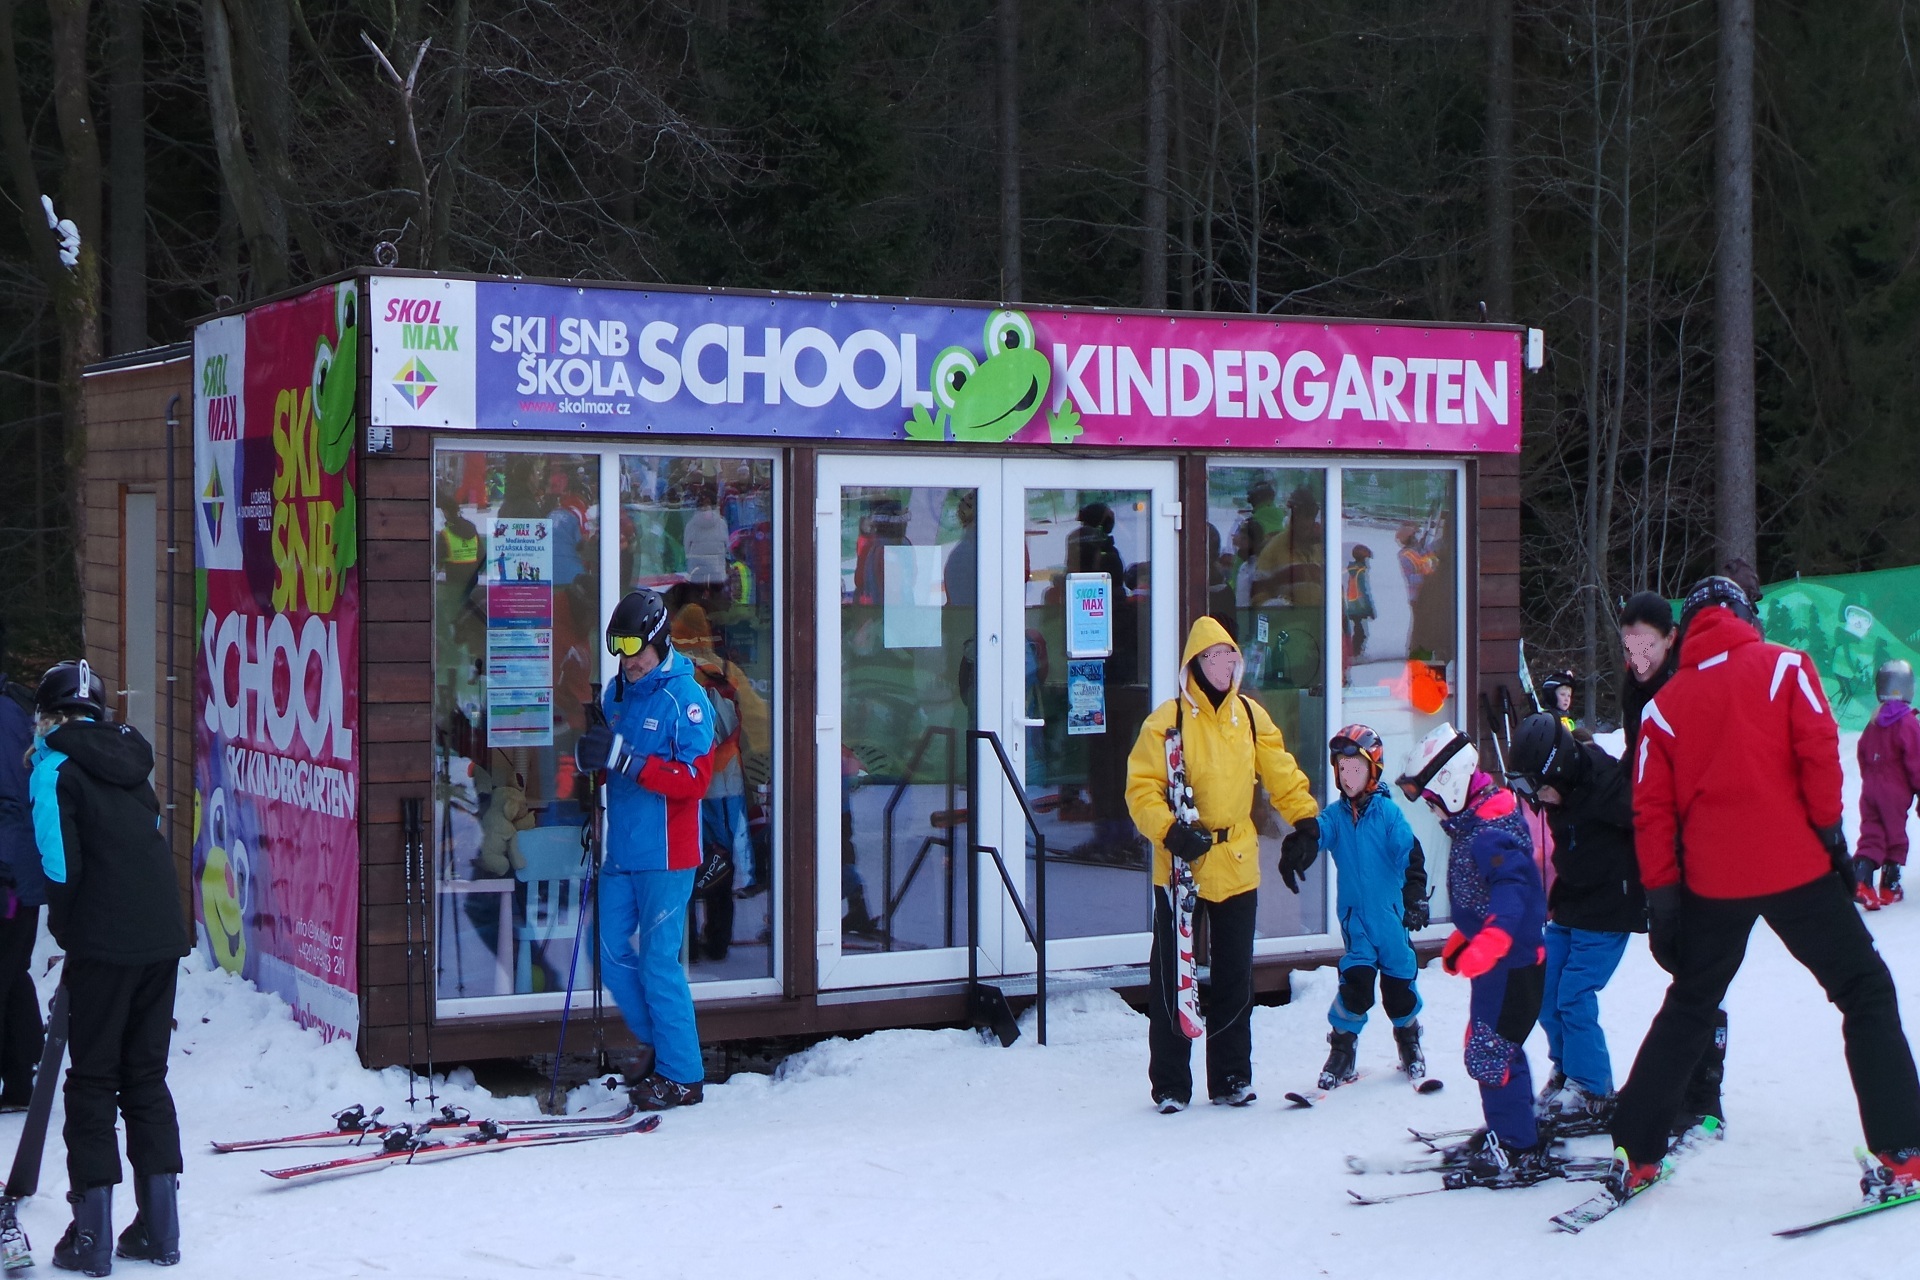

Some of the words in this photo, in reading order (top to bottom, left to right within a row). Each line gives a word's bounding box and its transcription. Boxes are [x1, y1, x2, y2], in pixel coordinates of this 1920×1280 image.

[384, 298, 442, 324] SKOL
[402, 324, 459, 351] MAX
[490, 314, 546, 354] SKI
[559, 317, 630, 357] SNB
[203, 353, 228, 397] SKOL
[516, 352, 635, 397] ŠKOLA
[637, 320, 935, 410] SCHOOL
[1052, 342, 1509, 425] KINDERGARTEN
[208, 395, 238, 441] MAX
[519, 397, 631, 415] www.skolmax.cz
[272, 386, 320, 501] SKI
[272, 500, 338, 614] SNB
[1075, 588, 1097, 599] SKOL
[1082, 599, 1104, 610] MAX
[203, 608, 353, 760] SCHOOL
[226, 744, 245, 791] SKI
[247, 749, 355, 820] KINDERGARTEN
